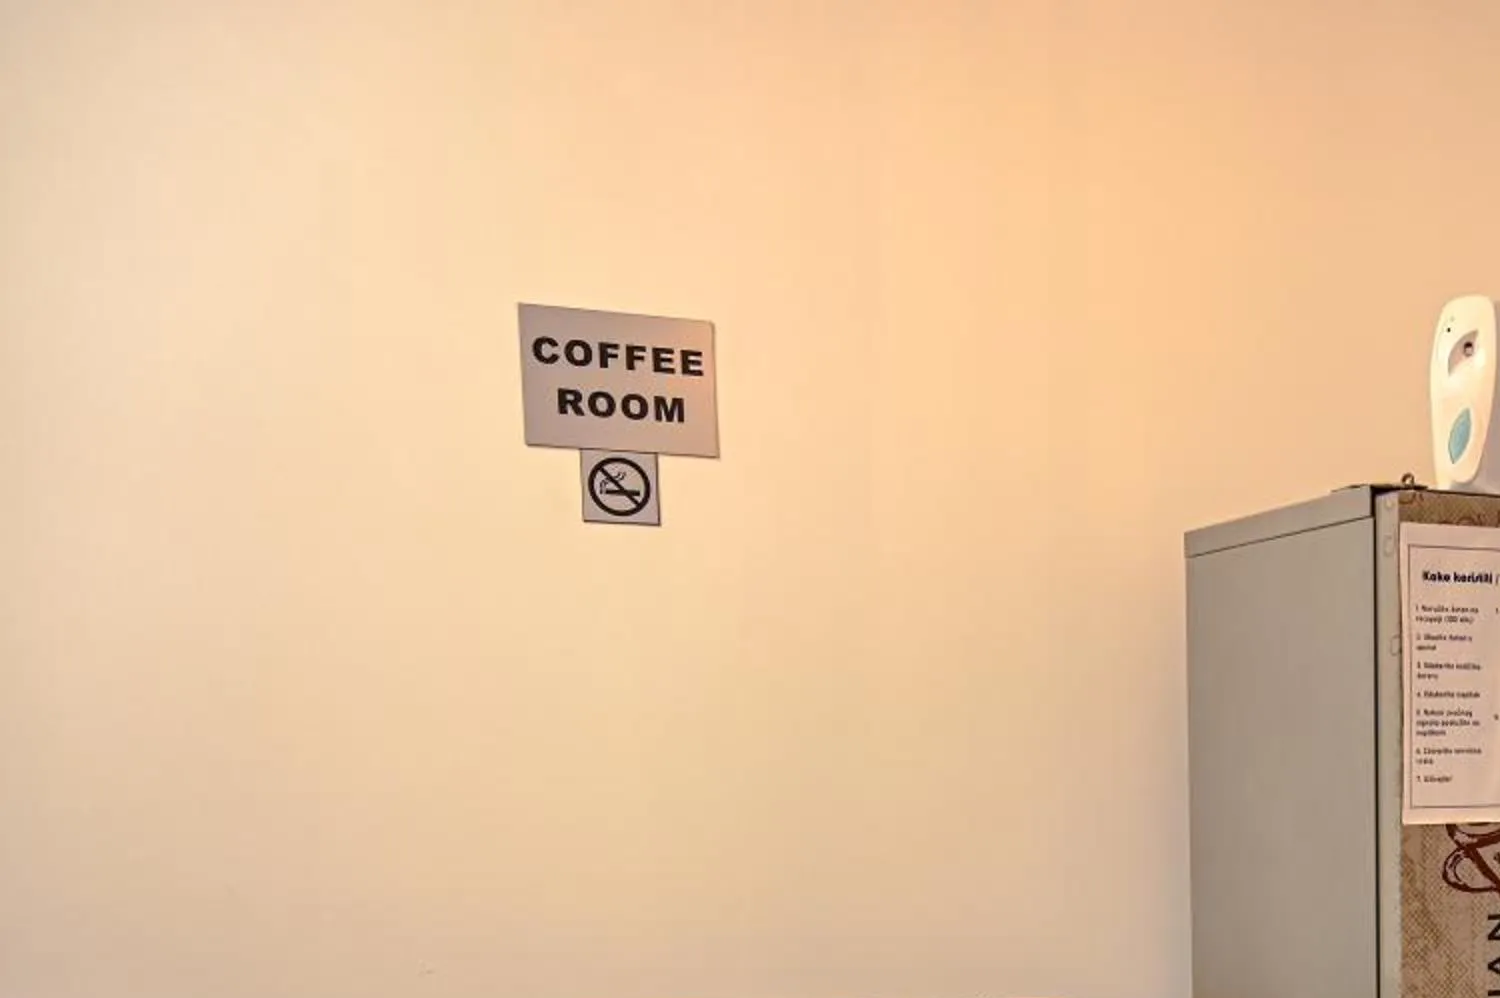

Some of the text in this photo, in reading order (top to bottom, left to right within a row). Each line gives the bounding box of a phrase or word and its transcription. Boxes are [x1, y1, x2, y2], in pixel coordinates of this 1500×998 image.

[532, 336, 704, 377] COFFEE
[557, 388, 685, 424] ROOM
[1422, 570, 1451, 583] Kako
